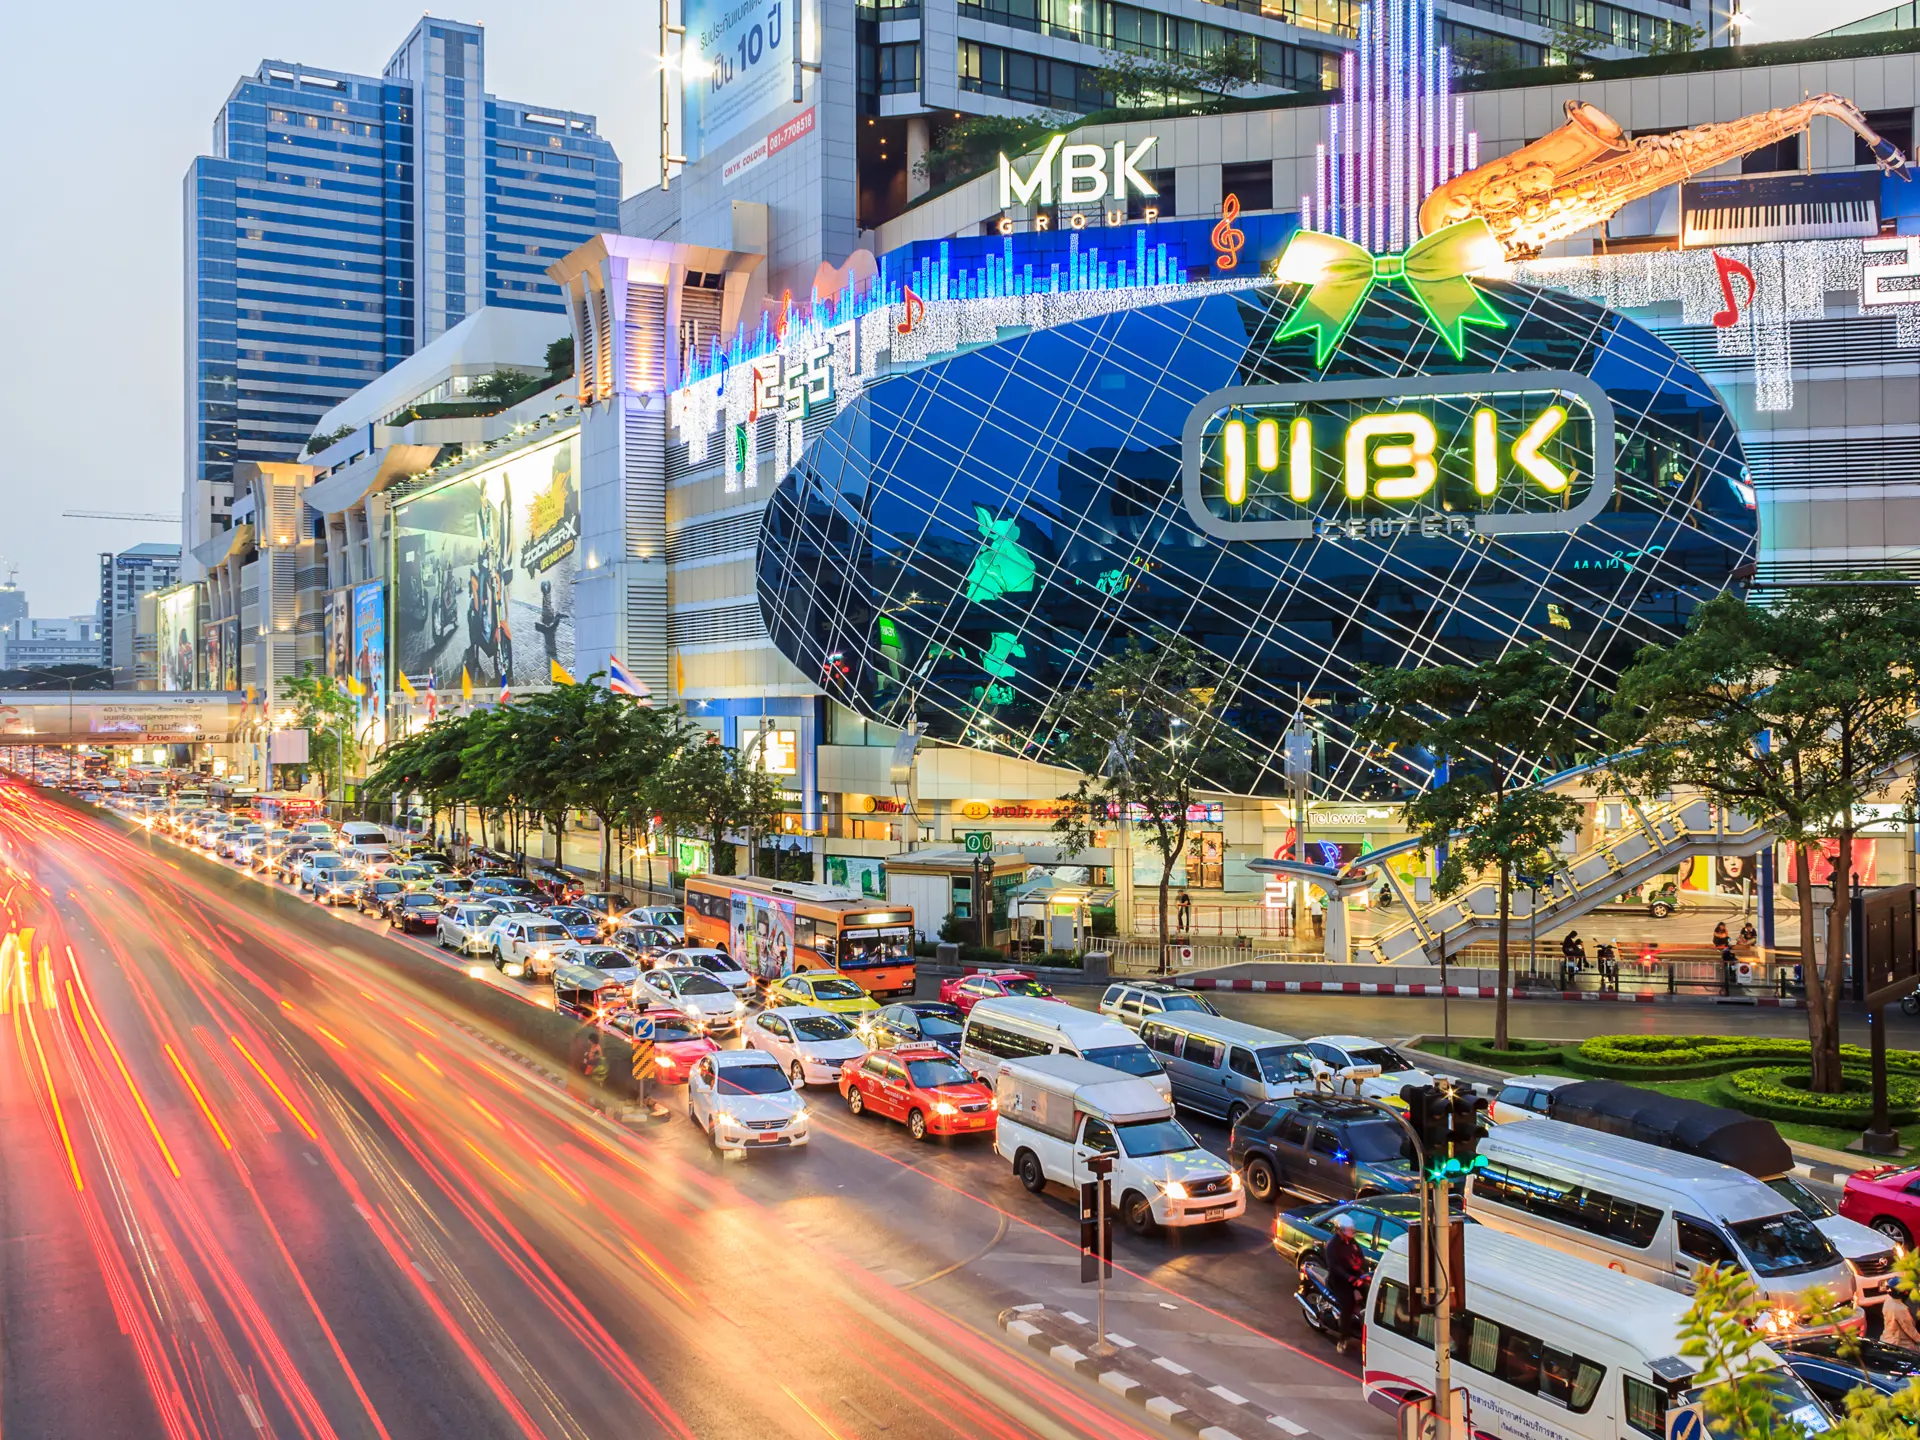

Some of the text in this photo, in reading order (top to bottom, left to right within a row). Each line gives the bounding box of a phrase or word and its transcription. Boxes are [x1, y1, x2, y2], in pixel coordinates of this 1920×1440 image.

[737, 23, 763, 72] 10
[767, 1, 782, 50] ปี
[724, 160, 741, 178] CMYK
[742, 145, 767, 166] COLOUR
[999, 134, 1160, 209] MBK
[999, 207, 1160, 235] GROUP
[1224, 406, 1568, 505] MBK
[1320, 514, 1470, 540] CENTER
[1308, 811, 1367, 824] Telewiz
[1435, 1360, 1440, 1373] 2
[1445, 1348, 1450, 1360] 2
